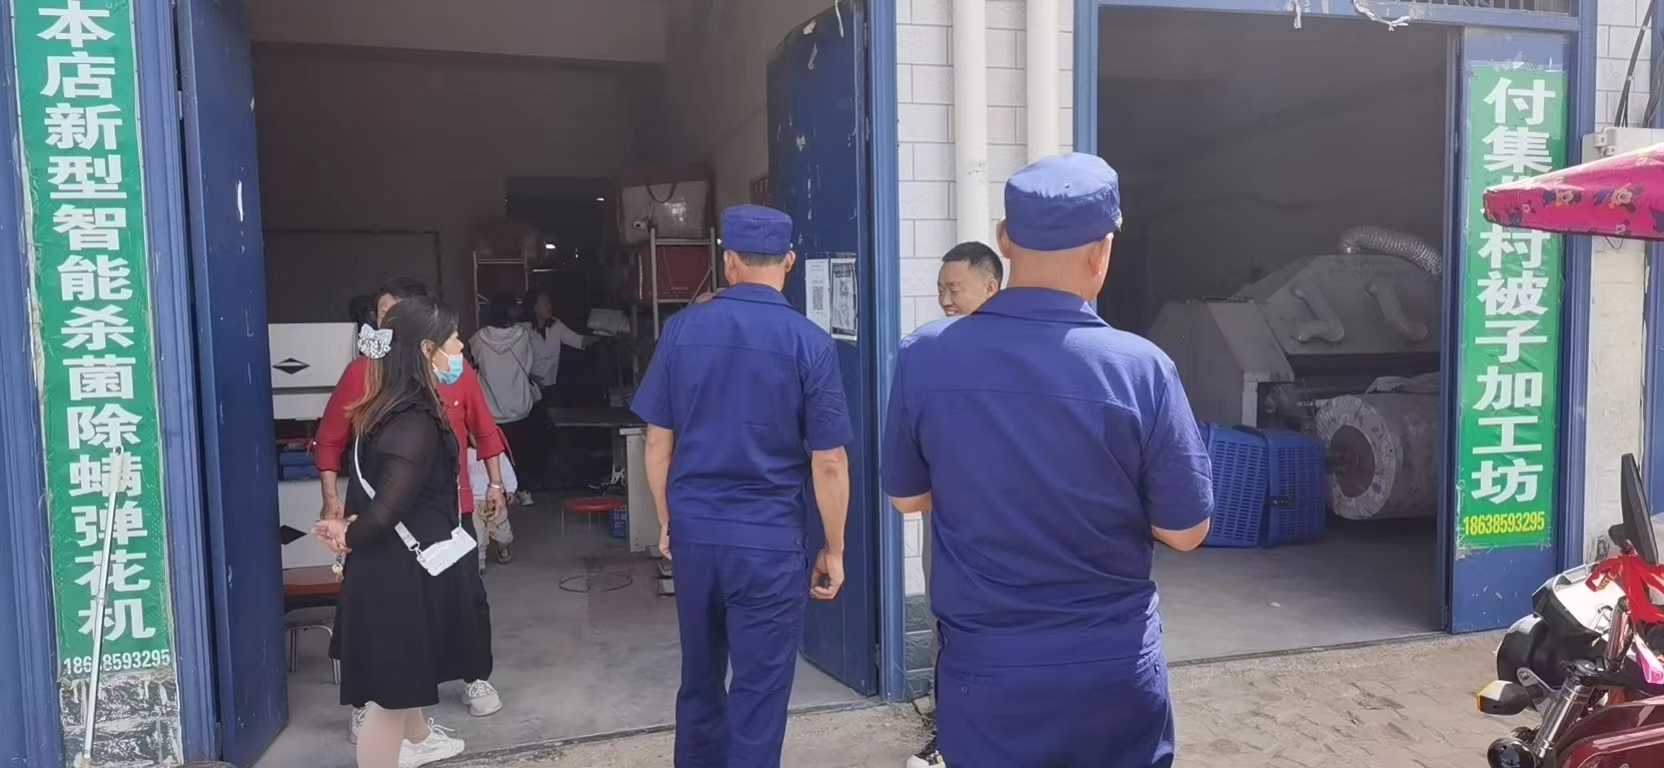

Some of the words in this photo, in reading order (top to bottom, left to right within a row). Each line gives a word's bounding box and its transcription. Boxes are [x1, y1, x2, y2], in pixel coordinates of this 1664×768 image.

[37, 0, 156, 641] 本店新型智能杀菌除螨弹花机
[1472, 78, 1555, 503] 付集村被子加工坊
[1463, 512, 1545, 535] 18638593295
[63, 648, 171, 675] 1868593295
